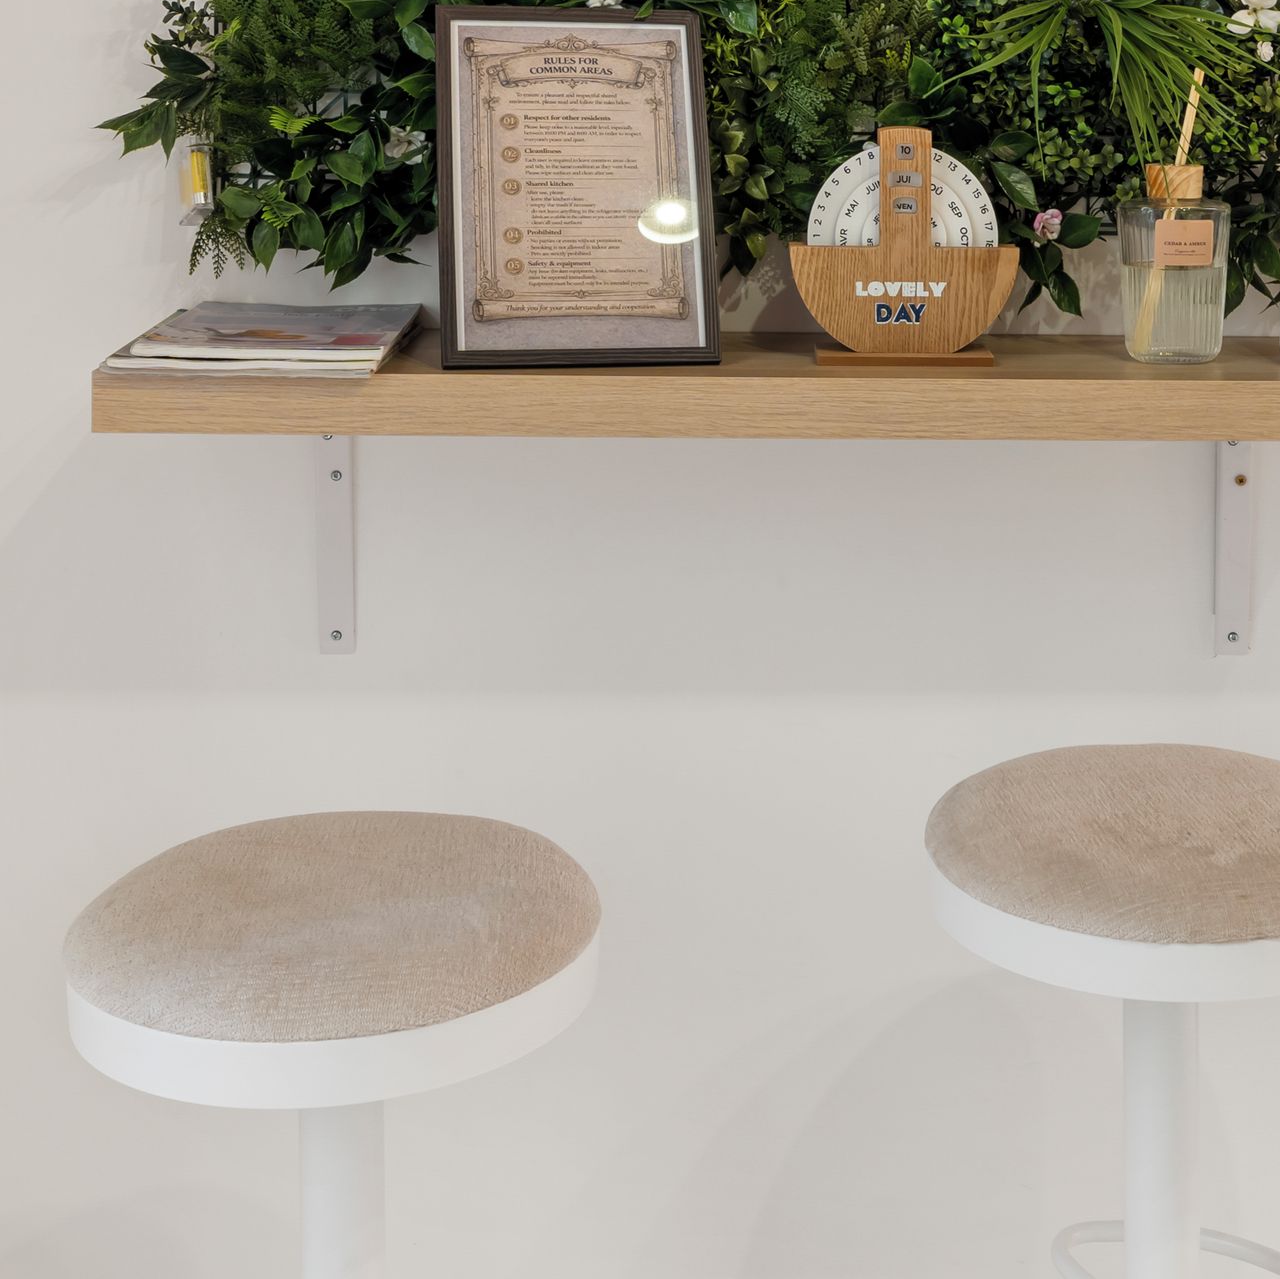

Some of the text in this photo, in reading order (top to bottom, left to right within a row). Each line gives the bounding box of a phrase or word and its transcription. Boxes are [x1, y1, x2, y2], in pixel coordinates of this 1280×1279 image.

[530, 66, 612, 75] COMMON AREAS
[900, 146, 911, 154] 10
[844, 166, 851, 174] 6
[933, 153, 942, 162] 12
[948, 161, 958, 171] 13
[962, 174, 972, 185] 14
[972, 188, 982, 198] 15
[980, 204, 989, 214] 16
[985, 222, 993, 231] 17
[845, 200, 859, 217] MAI
[948, 201, 962, 218] SEP
[960, 227, 969, 246] OCT
[856, 281, 947, 296] LOVELY
[875, 303, 926, 324] DAY
